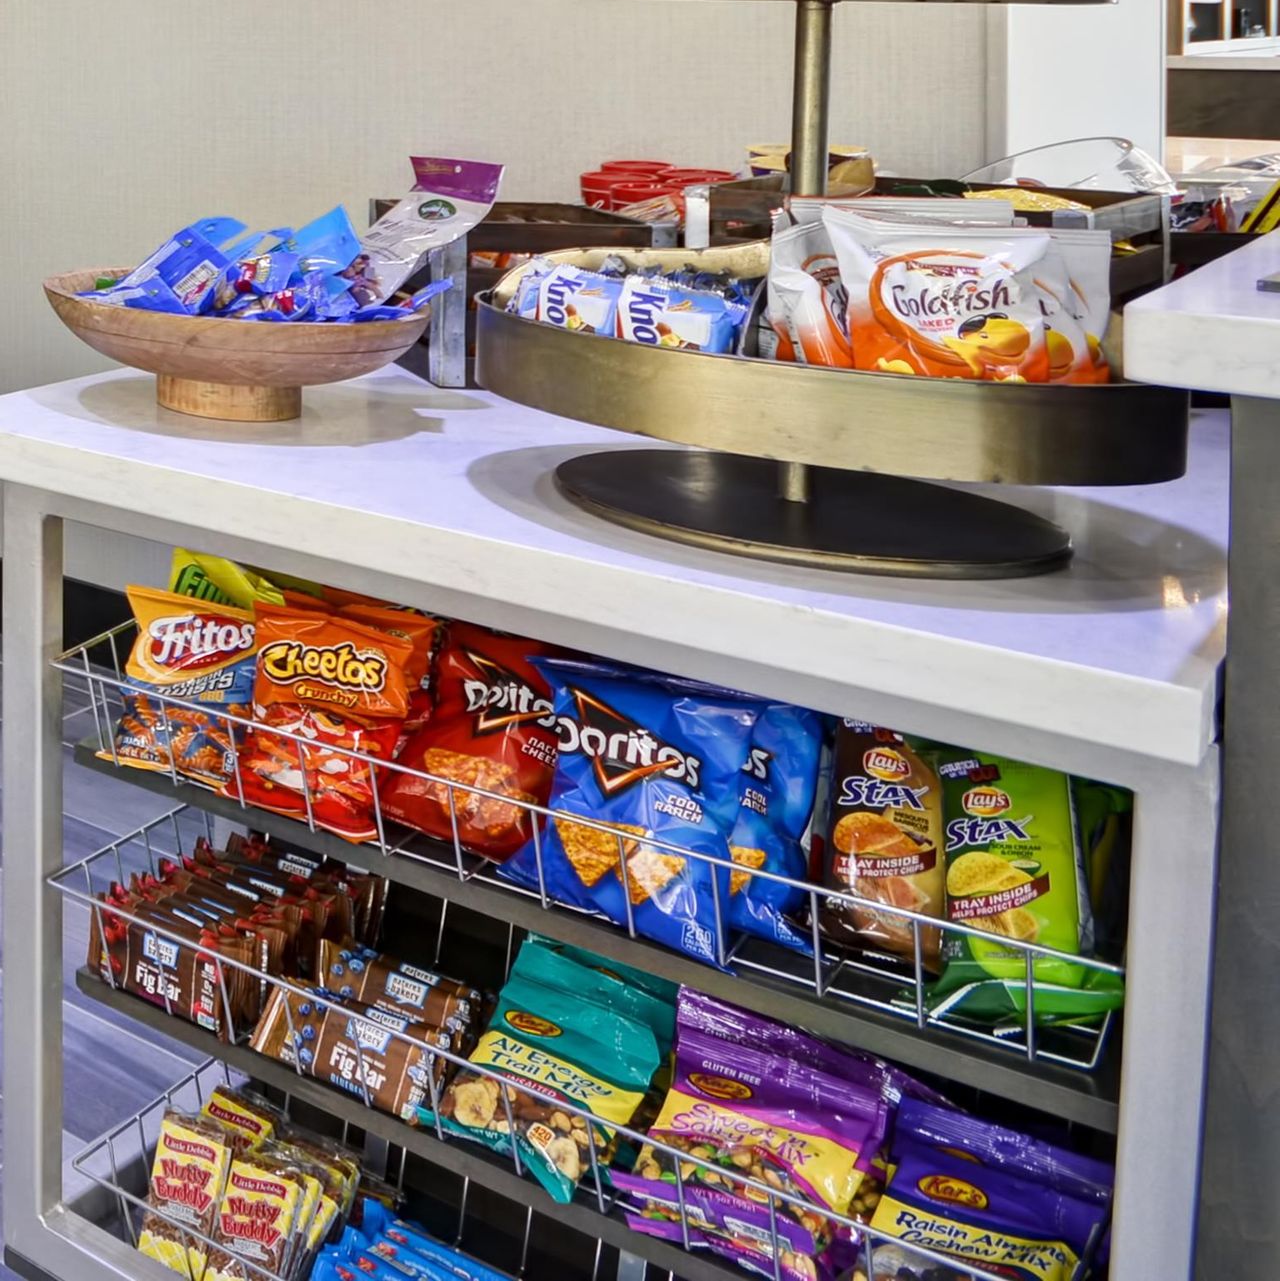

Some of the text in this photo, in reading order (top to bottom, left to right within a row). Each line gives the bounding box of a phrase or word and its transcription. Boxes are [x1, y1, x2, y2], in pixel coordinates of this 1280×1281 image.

[892, 278, 1010, 318] Goldfish
[148, 614, 256, 664] Fritos
[261, 642, 386, 689] Cheetos
[293, 682, 358, 706] Crunchy
[465, 679, 559, 733] Dorito
[527, 736, 558, 756] NACH
[556, 714, 701, 788] Doritos
[667, 794, 703, 814] COOL
[741, 795, 768, 816] ANCH
[745, 786, 767, 805] COOL
[841, 854, 920, 869] TAY INSIDE
[953, 883, 1032, 910] TRAY INSIDE
[976, 901, 1012, 916] PROTECT
[1013, 889, 1038, 907] CHIPS
[135, 964, 157, 995] Fig
[329, 1045, 387, 1091] Fig Bar
[489, 1036, 613, 1097] All Energy
[492, 1049, 594, 1099] Trail Mix
[702, 1060, 762, 1086] GLUTEN FREE
[211, 1104, 260, 1132] Little Debbie
[671, 1112, 745, 1143] Salty
[691, 1103, 779, 1140] Sweet
[165, 1135, 214, 1160] Little Debbie
[160, 1158, 213, 1191] Nutty
[234, 1175, 284, 1195] Little Debbie
[153, 1175, 213, 1214] Buddy
[931, 1175, 982, 1207] Kar's
[227, 1196, 282, 1225] Nutty
[895, 1210, 1069, 1265] Raisin Almond
[898, 1230, 986, 1261] Cashew
[998, 1248, 1052, 1274] Mix
